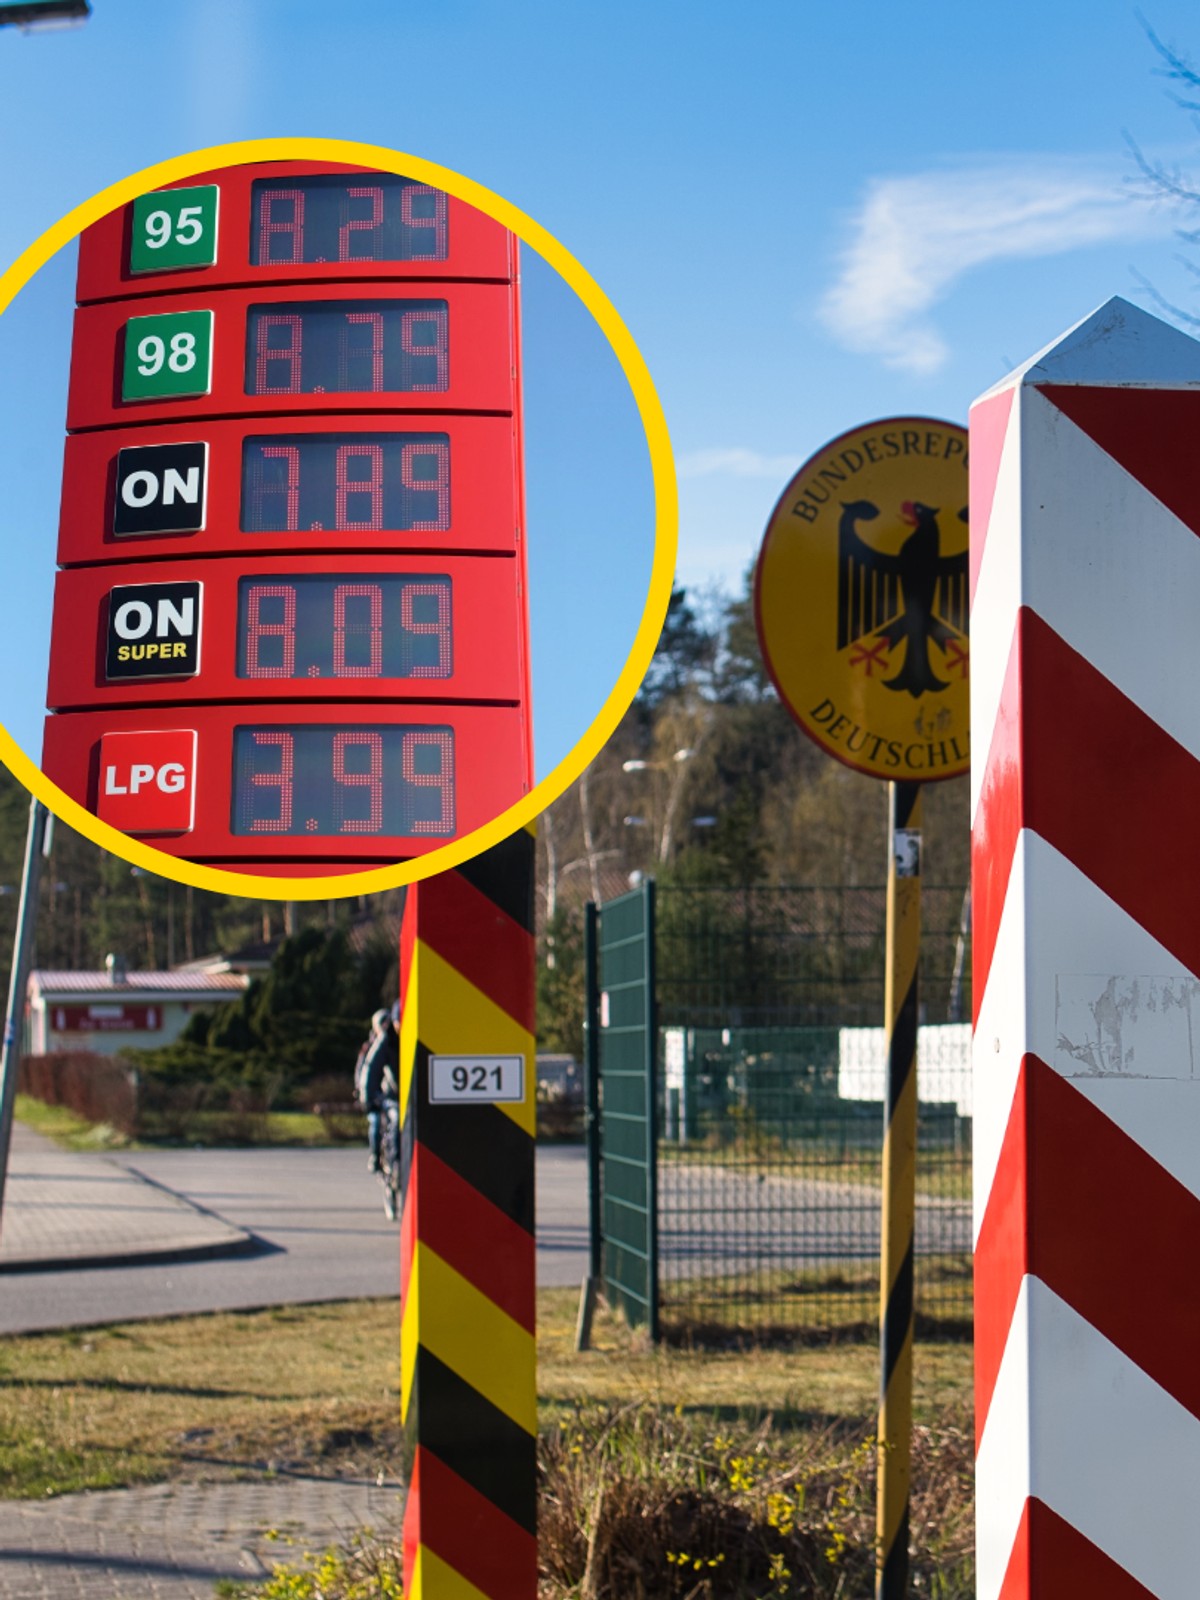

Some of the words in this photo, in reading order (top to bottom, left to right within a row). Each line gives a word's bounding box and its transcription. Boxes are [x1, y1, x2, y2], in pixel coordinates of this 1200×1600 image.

[144, 206, 204, 249] 95
[259, 184, 446, 266] 8.29
[136, 331, 197, 376] 98
[255, 310, 448, 395] 8.79
[121, 466, 199, 508] ON
[254, 443, 450, 531] 7.89
[114, 597, 194, 640] ON
[246, 584, 453, 679] 8.09
[117, 642, 187, 661] SUPER
[808, 699, 969, 770] DEUTSCHL
[105, 761, 187, 796] LPG
[248, 731, 454, 833] 3.99
[451, 1065, 503, 1092] 921
